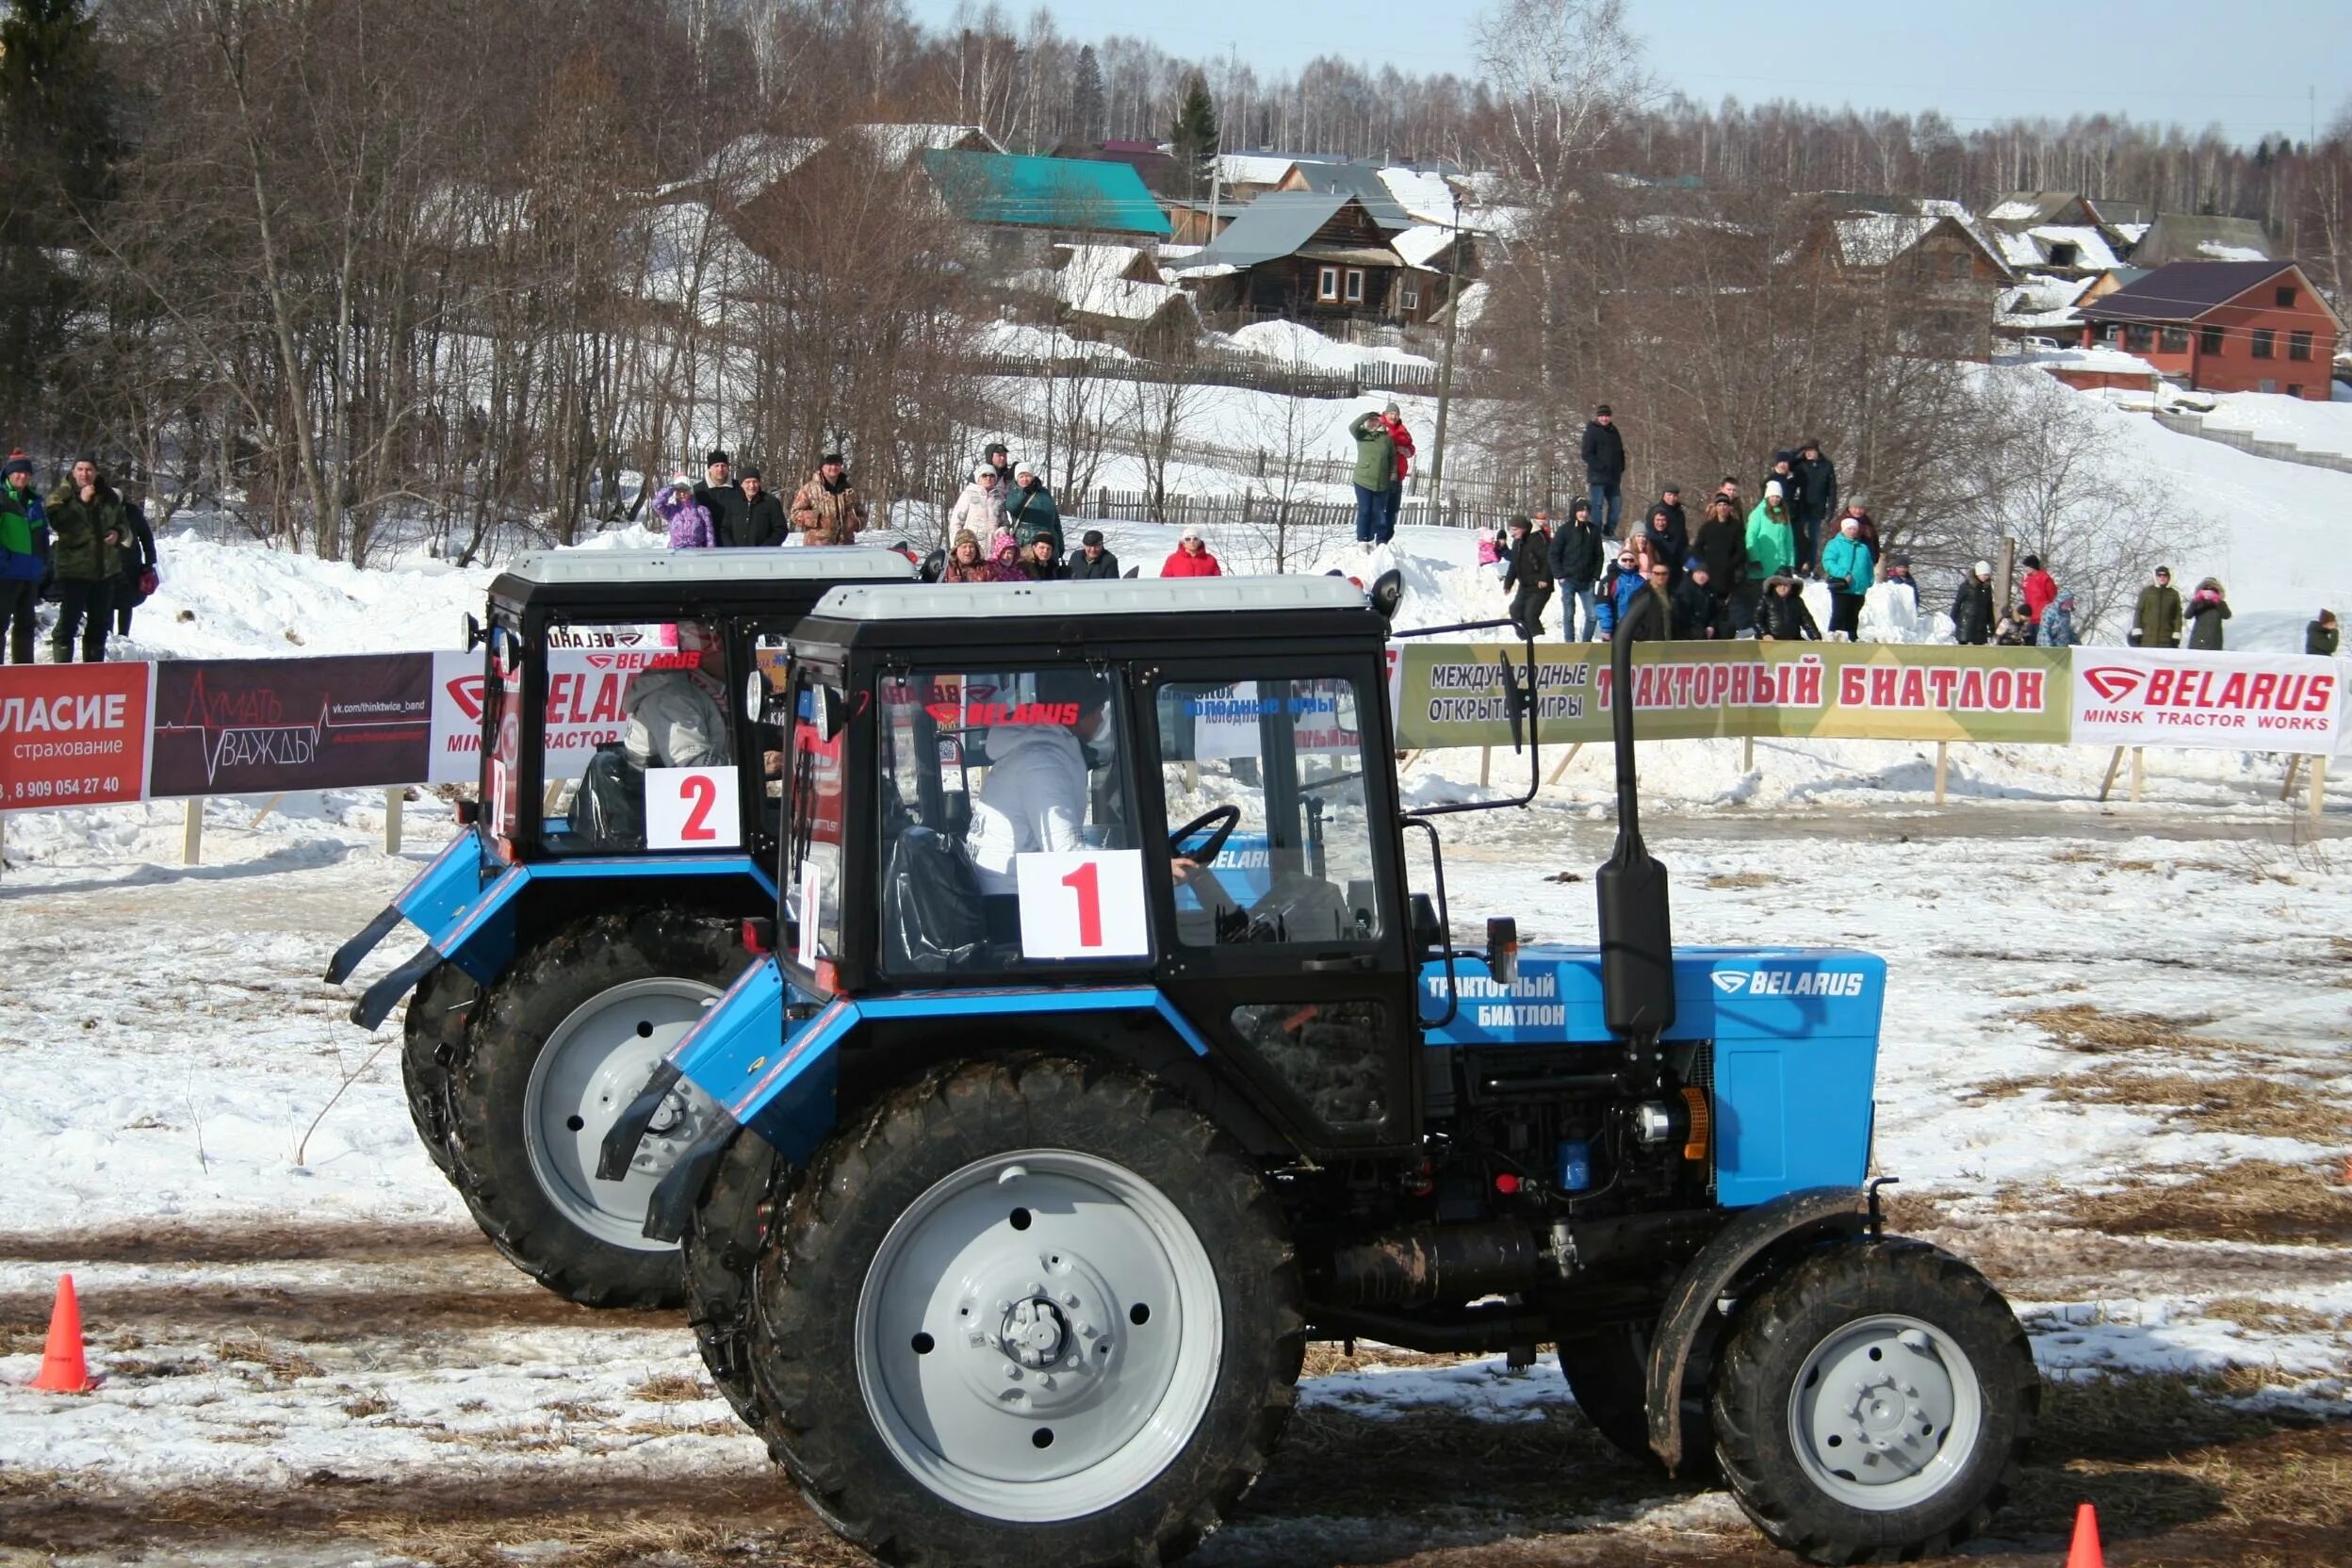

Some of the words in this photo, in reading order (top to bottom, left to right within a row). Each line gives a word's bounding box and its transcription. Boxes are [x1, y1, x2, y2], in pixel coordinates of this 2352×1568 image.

[615, 652, 702, 670] BELARUS
[1431, 663, 1588, 691] МЕЖДУНРДНЫЕ
[1596, 657, 1821, 708] ТАКТОРНЫЙ
[1840, 666, 2044, 709] БИАТЛОН
[2144, 669, 2335, 712] BELARUS
[0, 694, 126, 733] ЛАСИЕ
[333, 700, 425, 713] vk.com/thinktwice_band
[967, 702, 1080, 726] BELARUS
[2082, 709, 2145, 725] MINSK
[2155, 710, 2246, 728] TRACTOR
[2257, 716, 2329, 731] WORKS
[14, 739, 123, 761] страхование
[447, 734, 482, 752] MIN
[545, 730, 618, 750] RACTOR
[15, 782, 24, 799] 8
[27, 780, 52, 797] 909
[57, 778, 79, 795] 054
[84, 777, 100, 794] 27
[103, 776, 120, 792] 40
[679, 776, 716, 841] 2
[1207, 851, 1269, 868] ELAR
[1061, 861, 1102, 947] 1
[1749, 971, 1865, 996] BELARUS
[1478, 1004, 1565, 1026] БИАТЛОН
